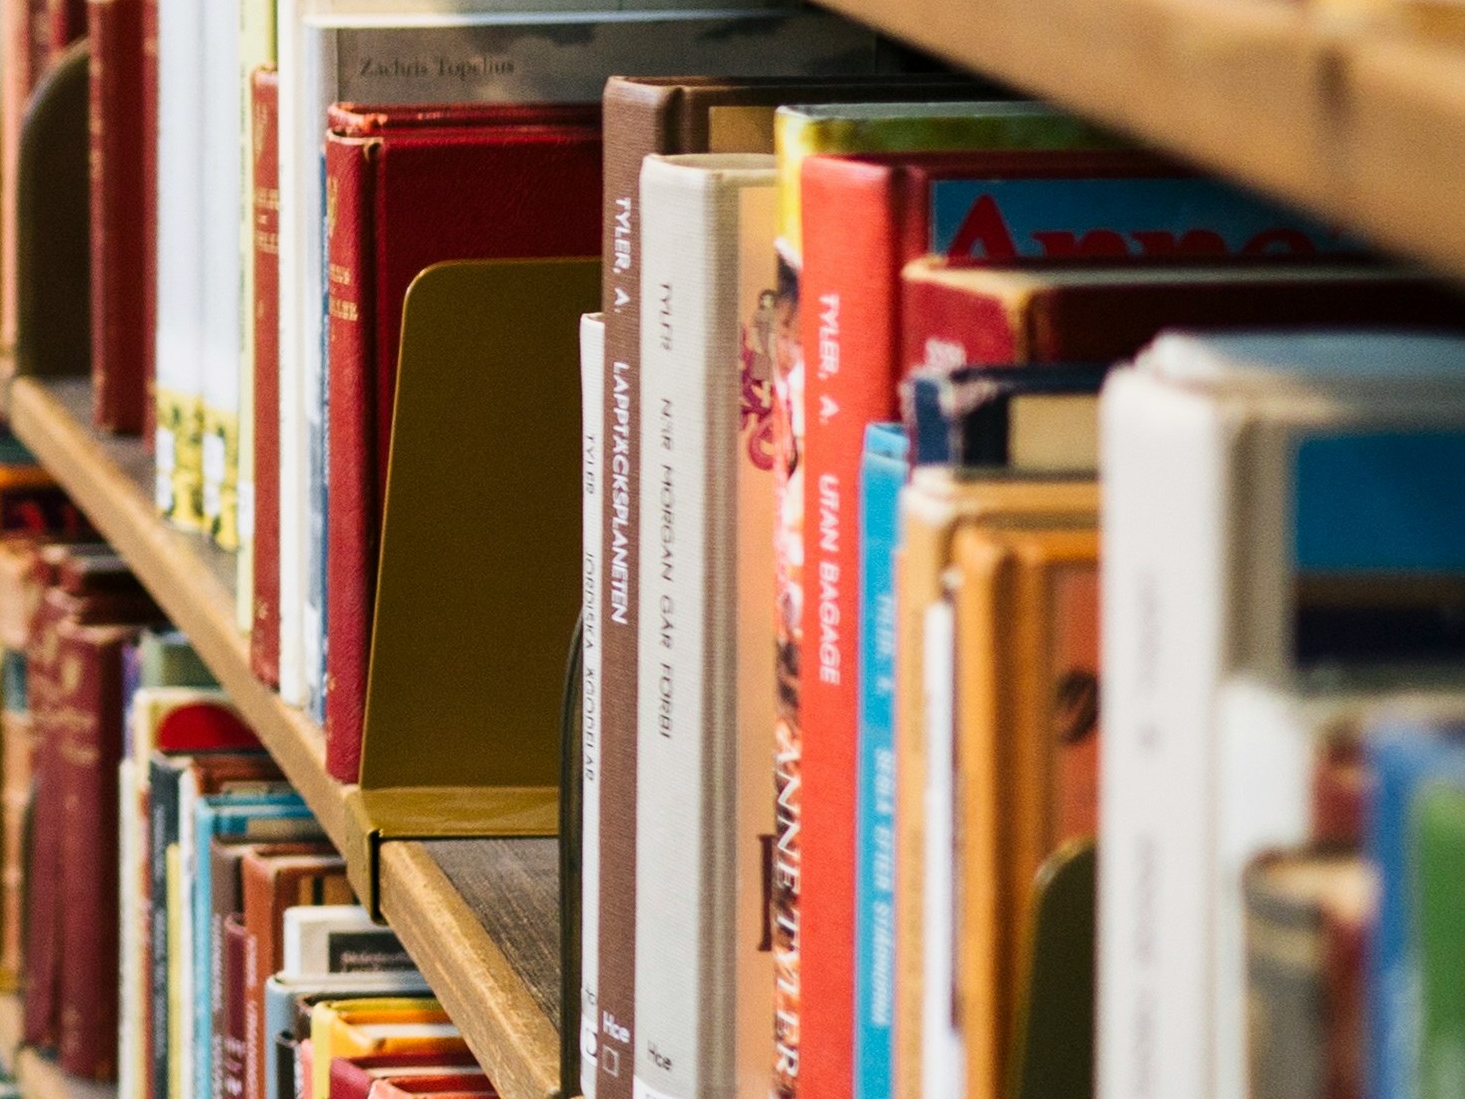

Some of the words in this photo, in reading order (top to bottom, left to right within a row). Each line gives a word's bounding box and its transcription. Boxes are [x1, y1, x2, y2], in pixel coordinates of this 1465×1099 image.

[360, 57, 428, 77] Zachris
[612, 196, 631, 274] TYLER,
[613, 286, 630, 314] A.
[659, 281, 674, 351] TYLER
[818, 293, 841, 380] TYLER,
[819, 395, 840, 425] A.
[610, 361, 631, 624] LAPPTÄCKSPLANETEN
[660, 464, 674, 582] MORGAN
[818, 473, 840, 553] UTAN
[819, 561, 841, 686] BAGAGE
[774, 725, 801, 895] ANNE
[873, 824, 893, 891] EFTER
[602, 1010, 631, 1044] Hce
[774, 907, 801, 1077] TYLER
